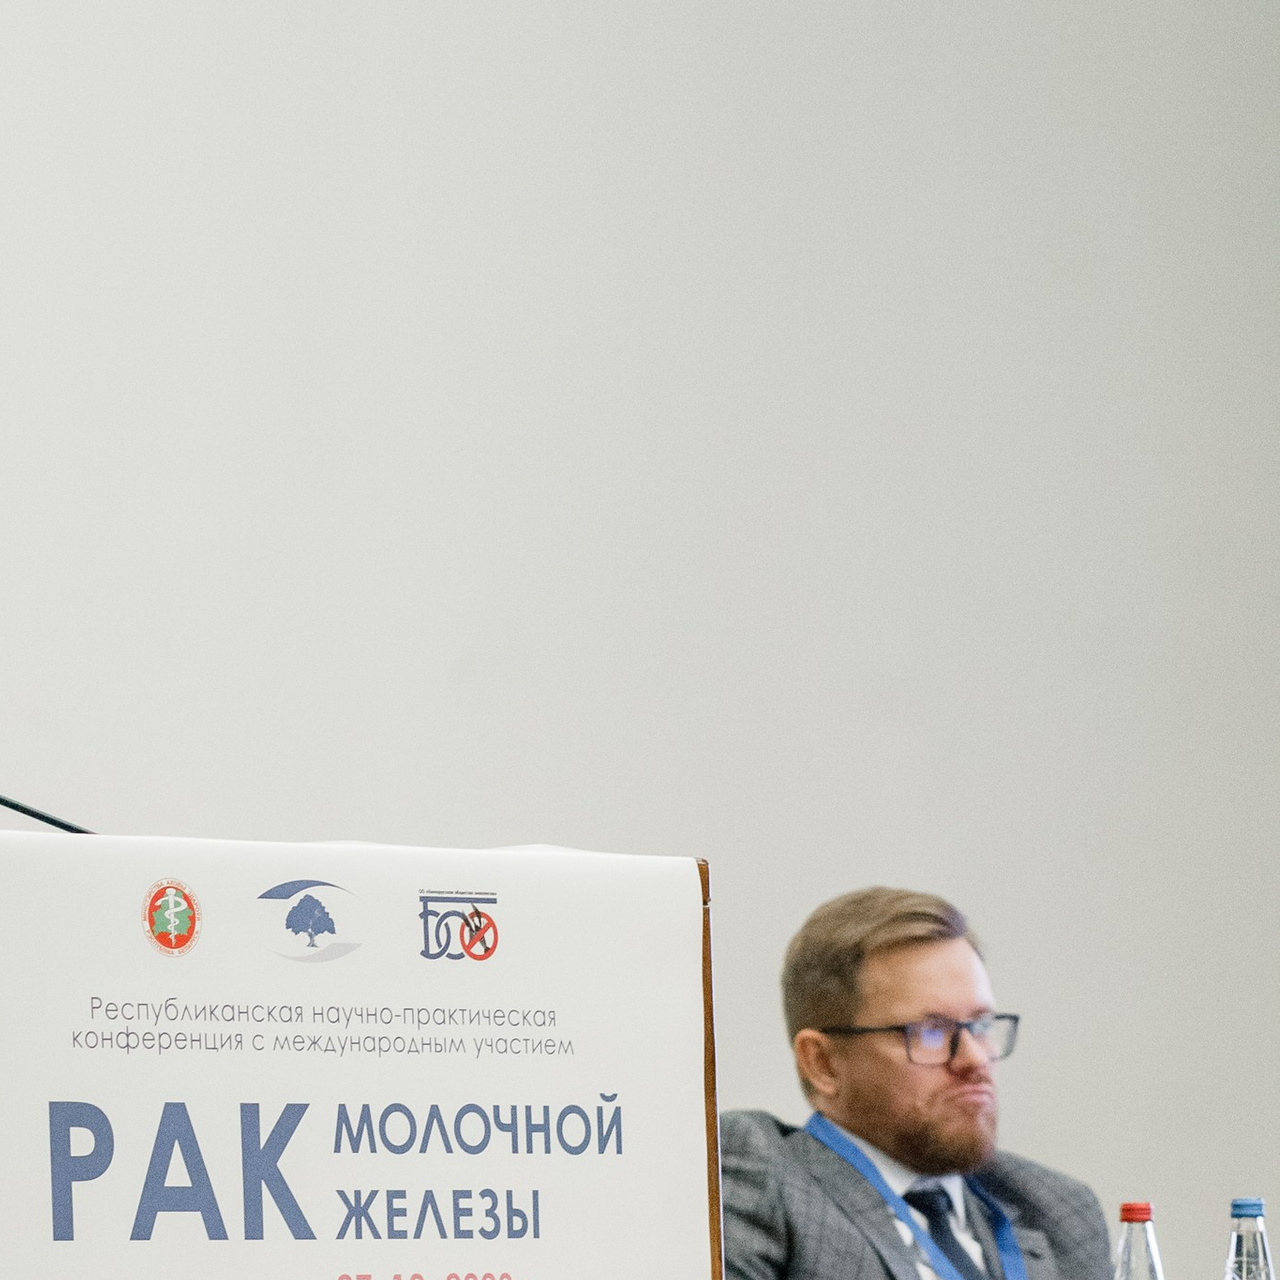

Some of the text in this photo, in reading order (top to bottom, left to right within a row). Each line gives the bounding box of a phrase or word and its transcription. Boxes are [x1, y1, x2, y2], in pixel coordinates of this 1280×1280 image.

[90, 996, 557, 1031] Республиканская научно-практическая
[72, 1025, 575, 1059] конференция с международным участием
[333, 1092, 623, 1156] МОЛОЧНОЙ
[48, 1100, 318, 1242] РАК
[335, 1187, 541, 1240] ЖЕЛЕЗЫ
